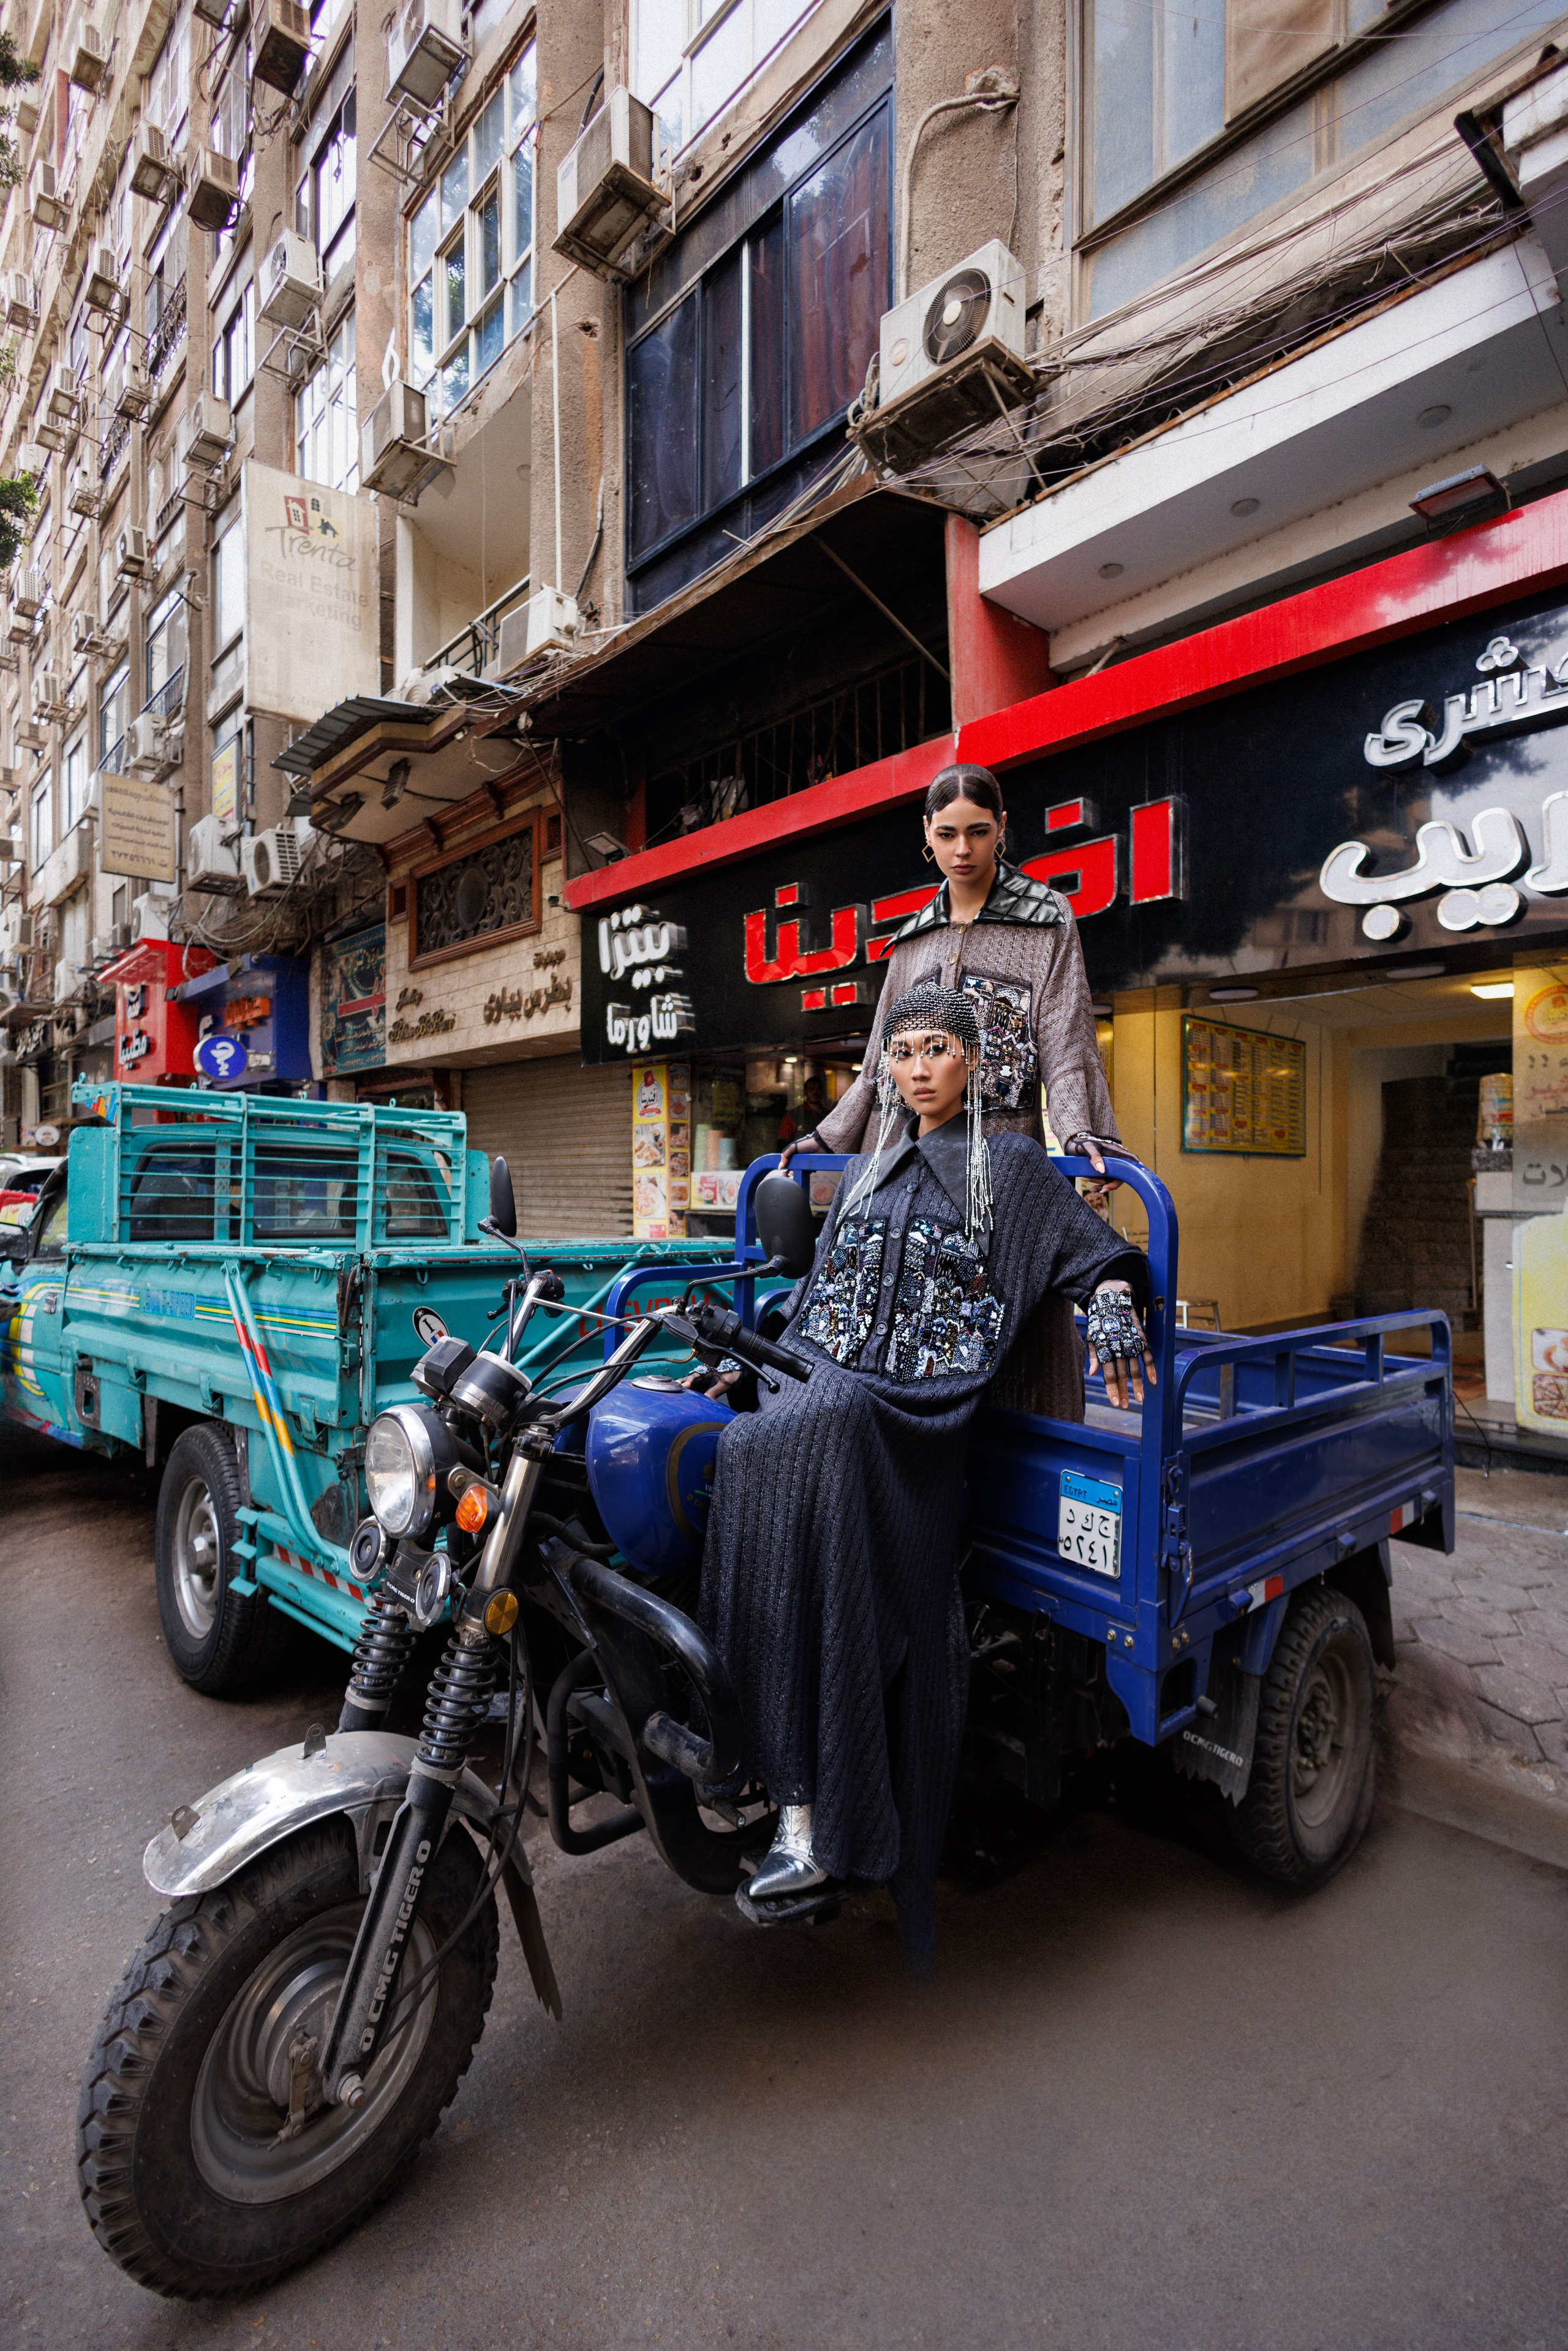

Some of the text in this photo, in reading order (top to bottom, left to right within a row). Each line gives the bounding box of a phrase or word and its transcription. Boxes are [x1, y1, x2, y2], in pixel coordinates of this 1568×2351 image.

[265, 526, 360, 571] Trenta
[260, 560, 368, 607] Real Estate
[1364, 636, 1568, 766] شرى
[744, 795, 1172, 1012] افدينا
[598, 904, 671, 990] بيتزا
[607, 993, 678, 1054] شاورما
[1065, 1485, 1087, 1499] EGYPT
[1096, 1495, 1118, 1506] مصر
[1066, 1508, 1111, 1538] ج ك د
[1063, 1534, 1107, 1569] ٥٢٤١
[398, 1590, 411, 1601] TIGER
[1212, 1744, 1236, 1764] TIGER
[369, 1949, 399, 2023] CMG
[390, 1865, 424, 1944] TIGER
